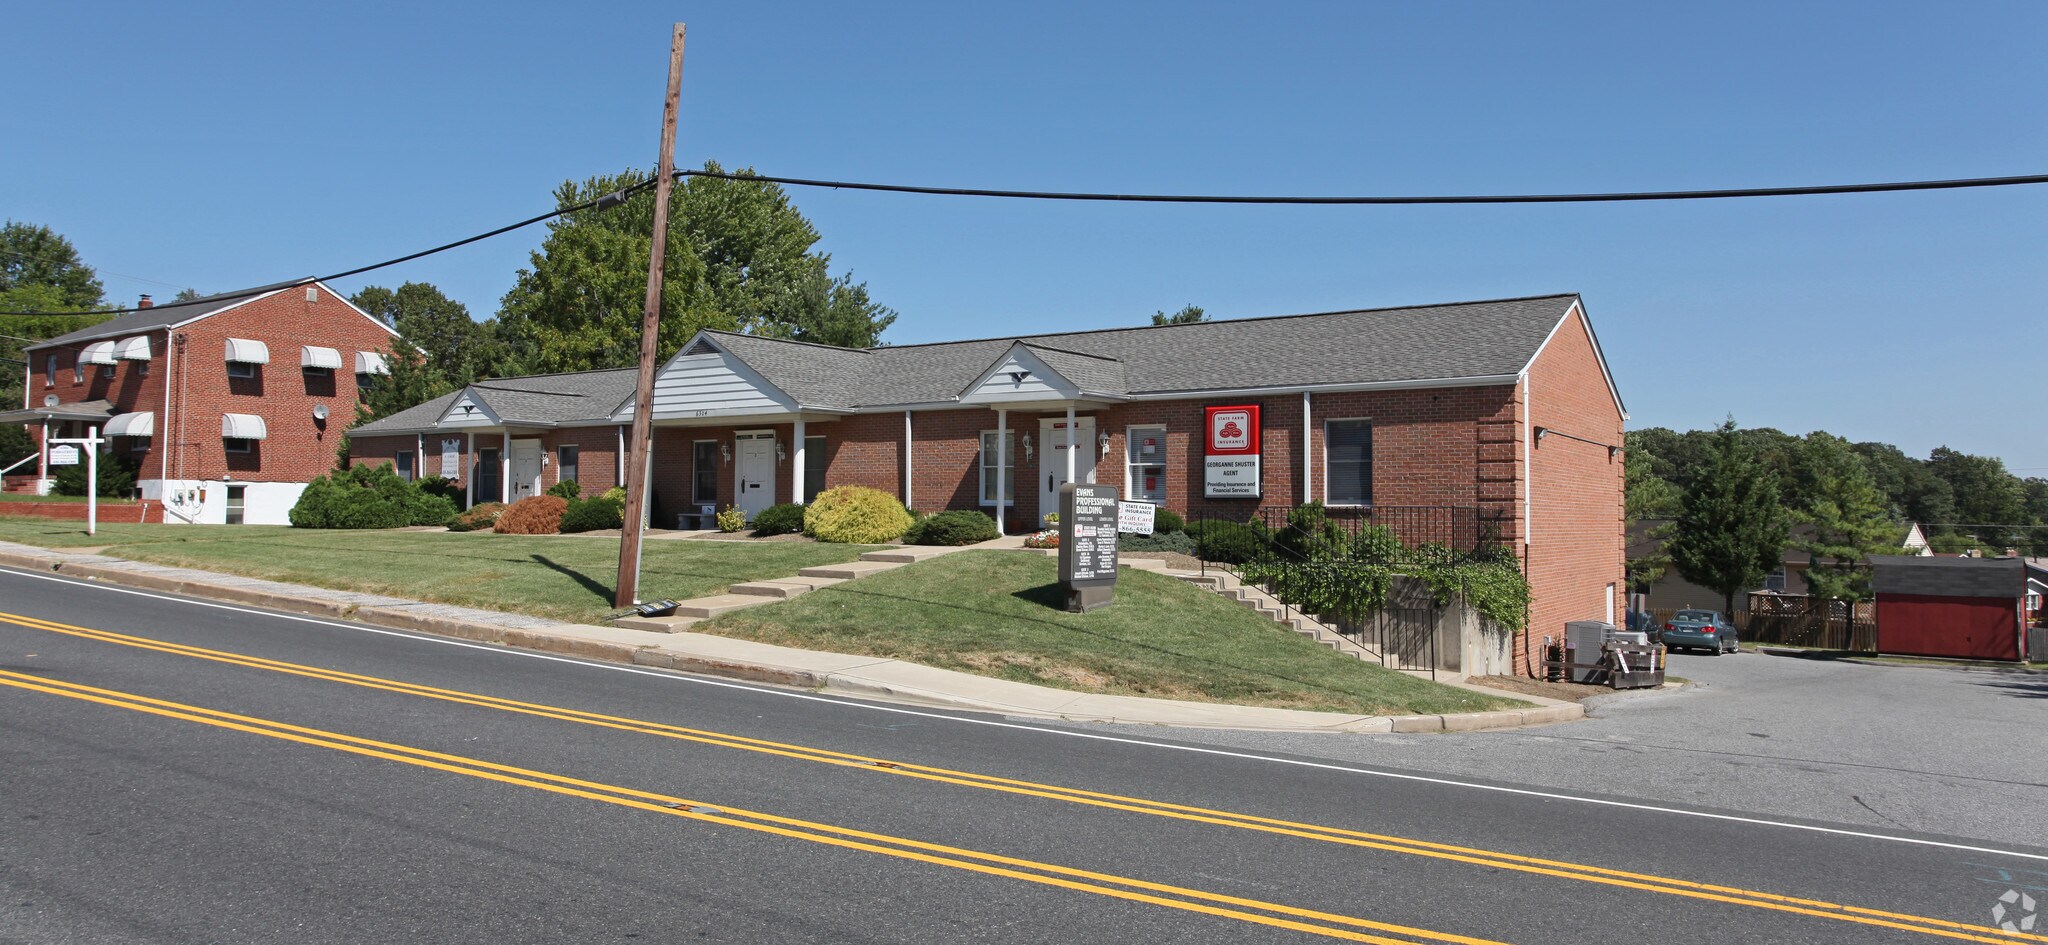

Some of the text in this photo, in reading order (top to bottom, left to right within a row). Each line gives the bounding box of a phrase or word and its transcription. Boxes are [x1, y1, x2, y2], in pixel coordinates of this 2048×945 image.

[1076, 488, 1094, 496] EVANS
[1076, 497, 1115, 506] PROFESSIONAL
[1076, 506, 1103, 514] BUILDING
